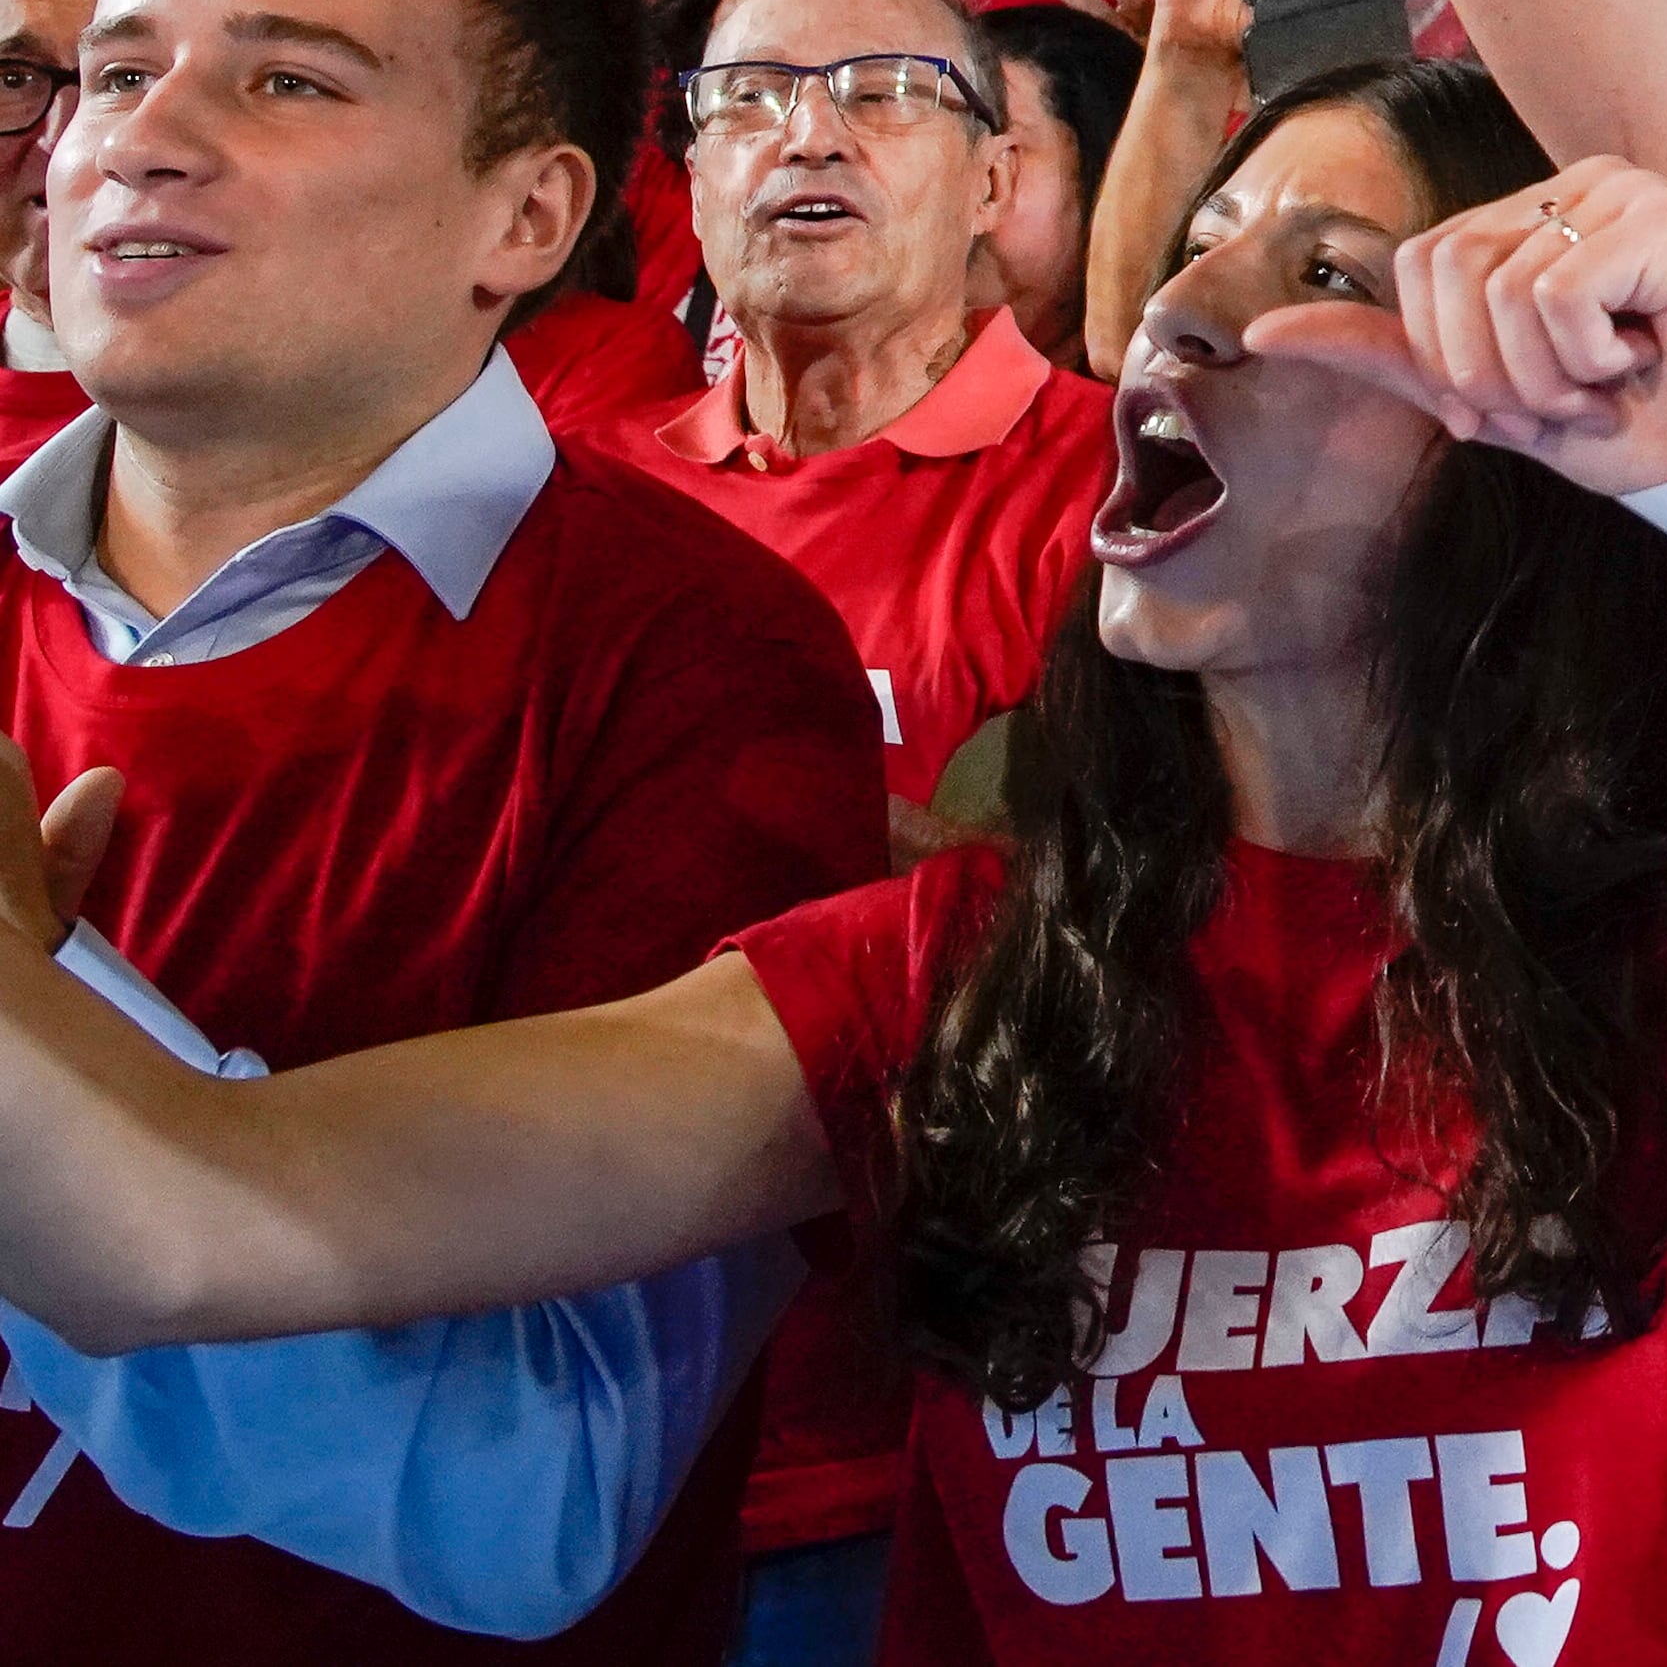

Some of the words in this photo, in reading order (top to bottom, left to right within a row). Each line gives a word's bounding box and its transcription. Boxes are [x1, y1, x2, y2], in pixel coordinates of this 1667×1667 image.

[1070, 1219, 1613, 1378] UERZ
[1092, 1374, 1205, 1452] LA
[1002, 1428, 1581, 1606] GENTE.
